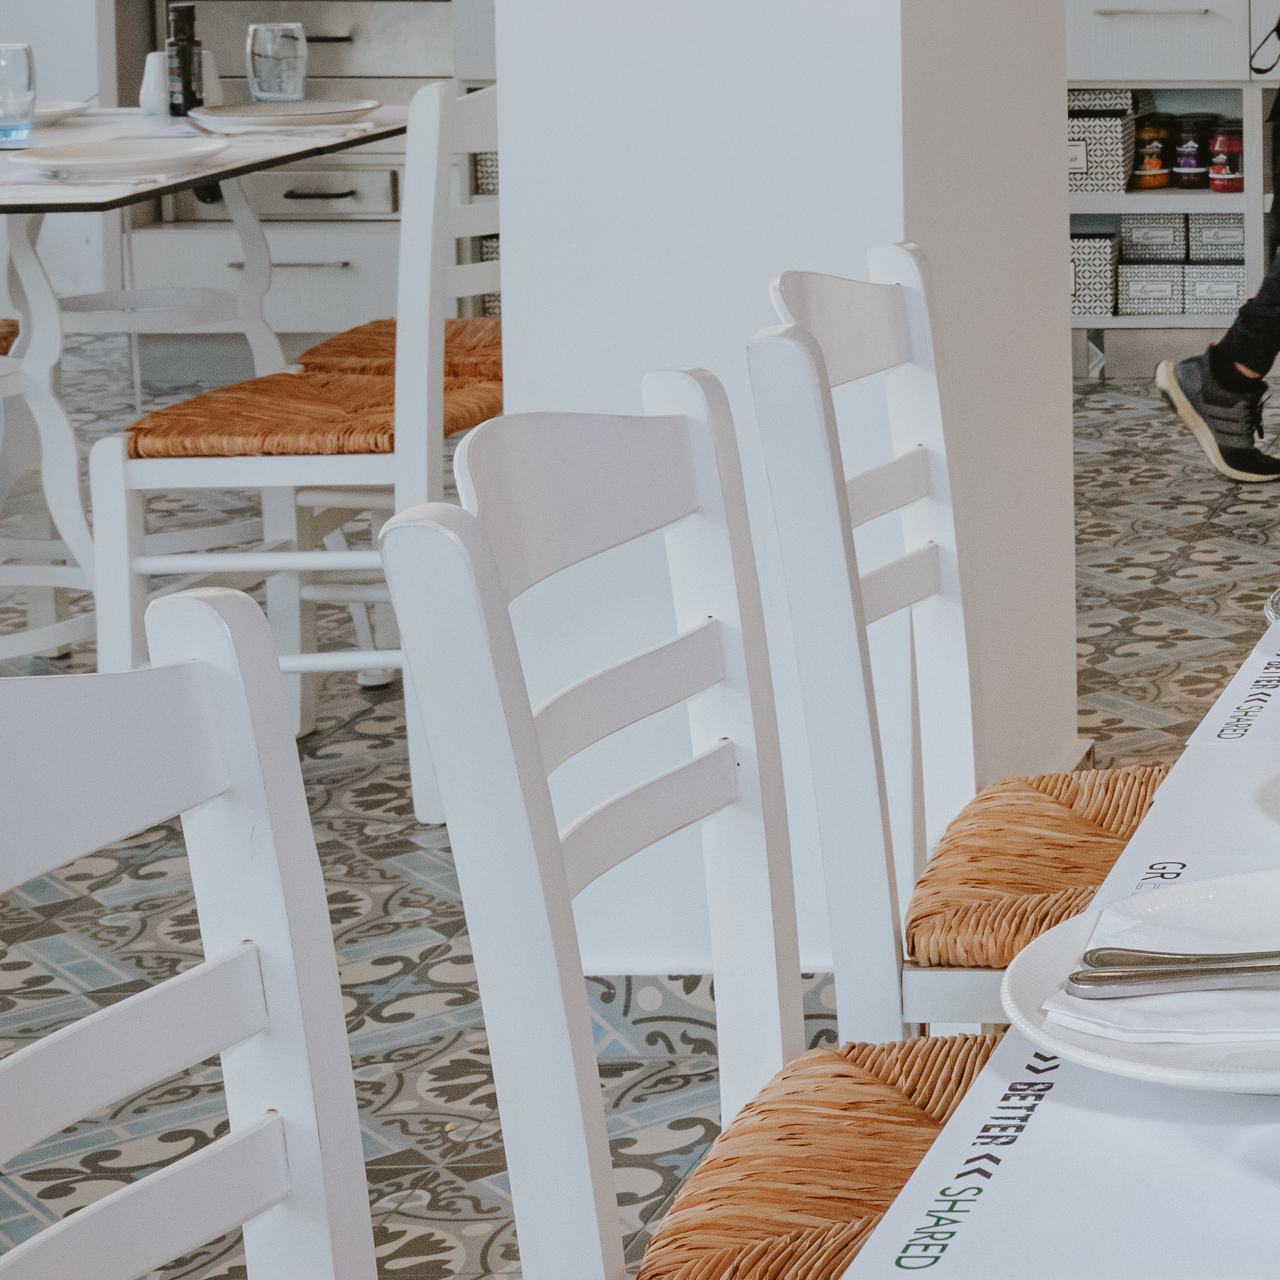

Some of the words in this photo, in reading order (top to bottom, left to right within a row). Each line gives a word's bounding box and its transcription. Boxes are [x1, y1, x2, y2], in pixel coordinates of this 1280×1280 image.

[1216, 705, 1265, 740] SHARED
[970, 1081, 1056, 1147] BETTER
[894, 1186, 984, 1270] SHARED
